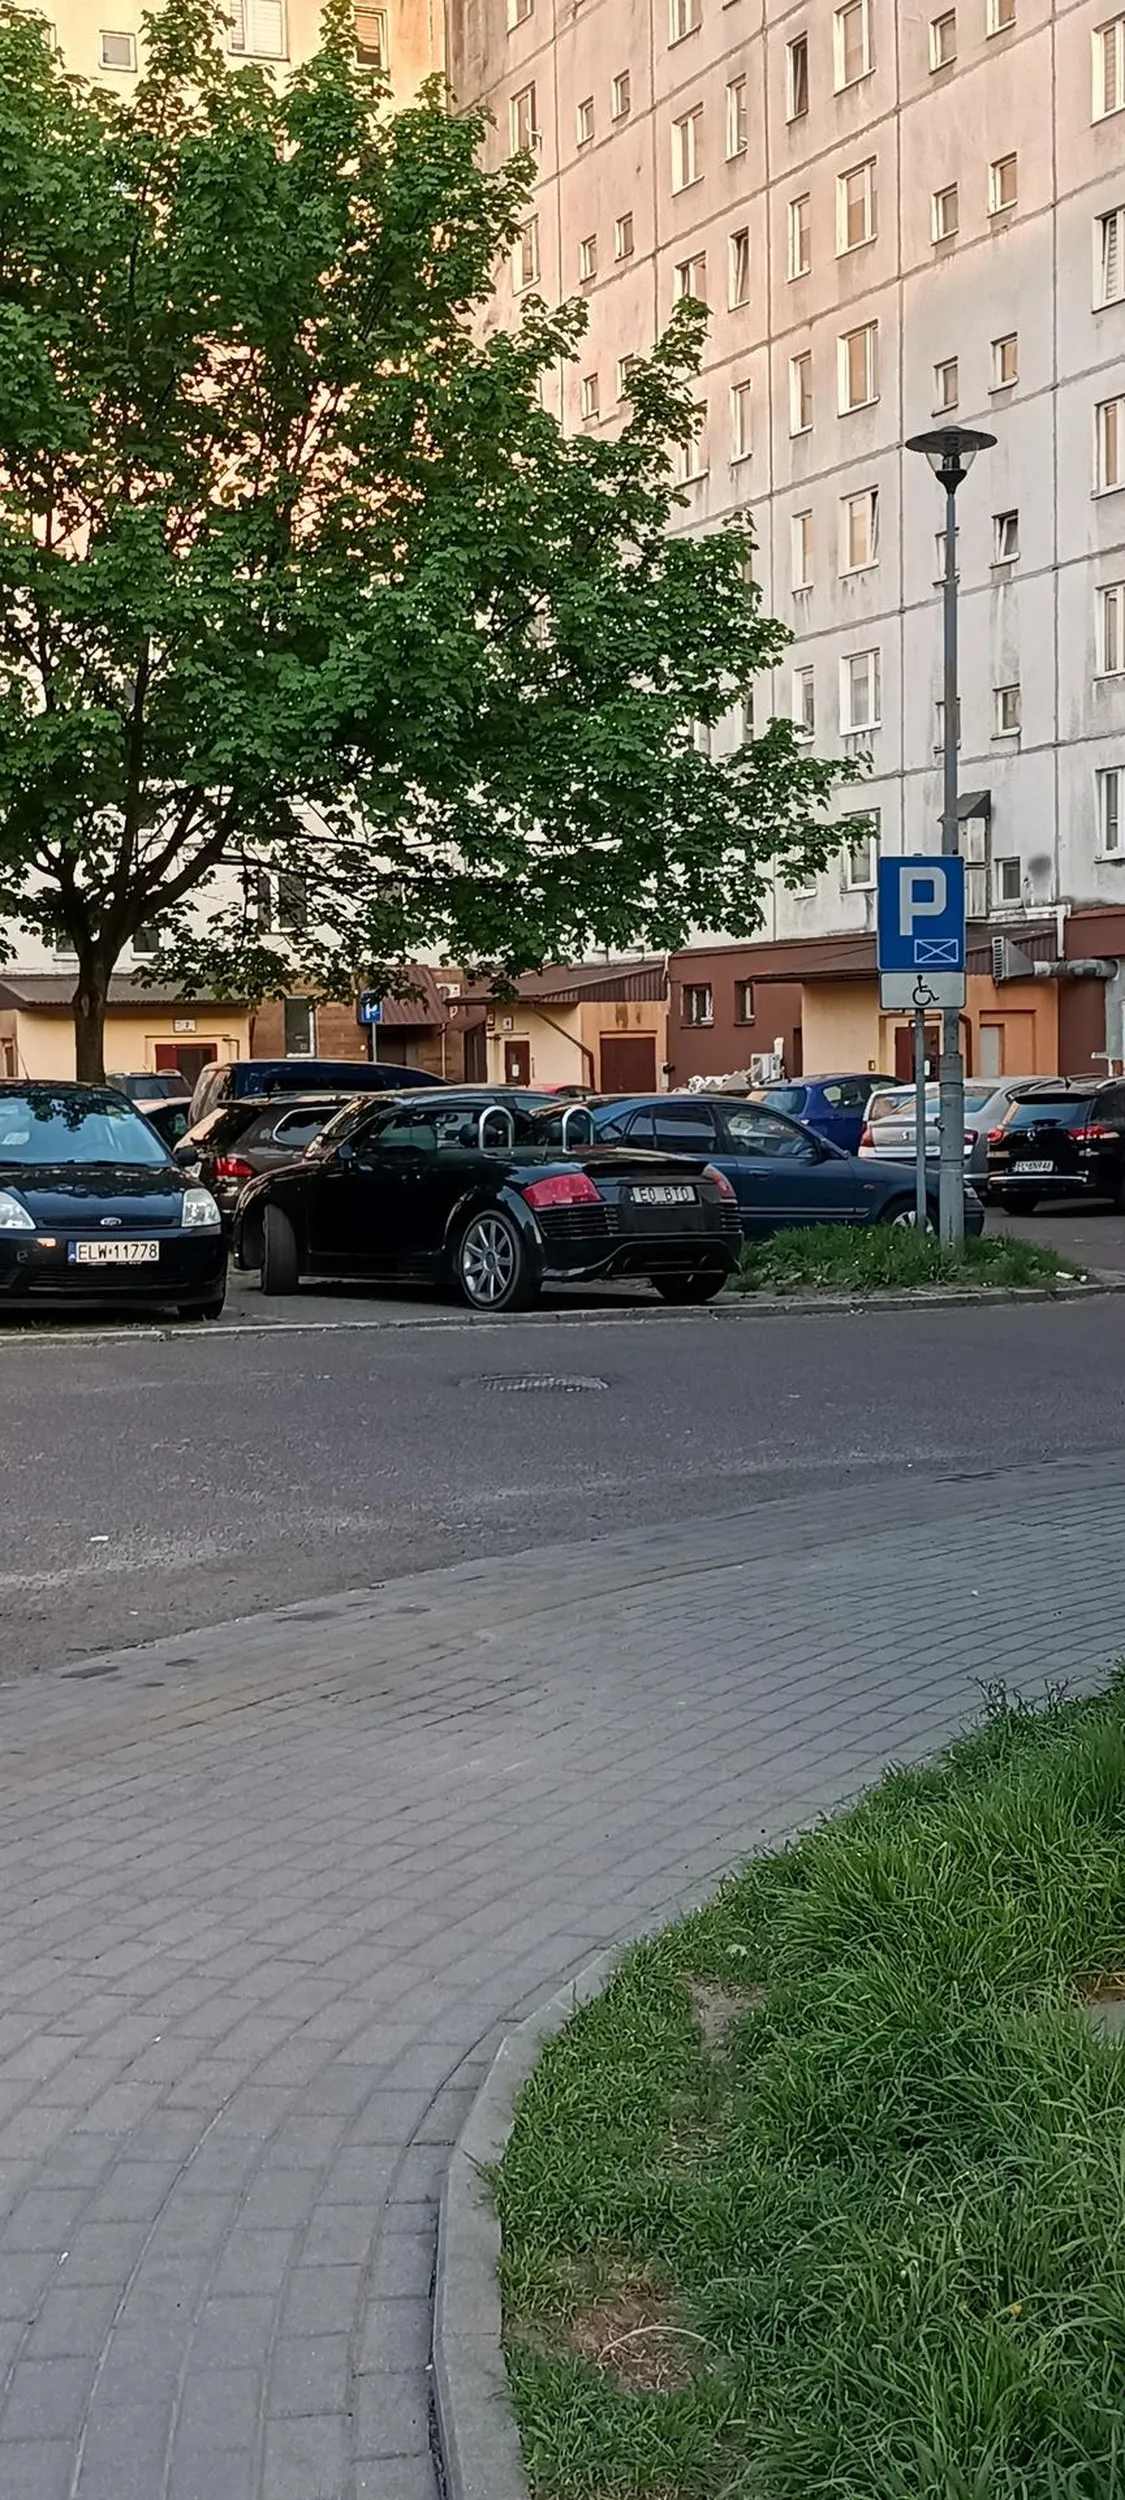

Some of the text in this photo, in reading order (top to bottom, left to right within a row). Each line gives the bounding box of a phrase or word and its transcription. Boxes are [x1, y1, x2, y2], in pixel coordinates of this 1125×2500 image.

[899, 866, 947, 936] P
[78, 1243, 157, 1260] ELW 11778
